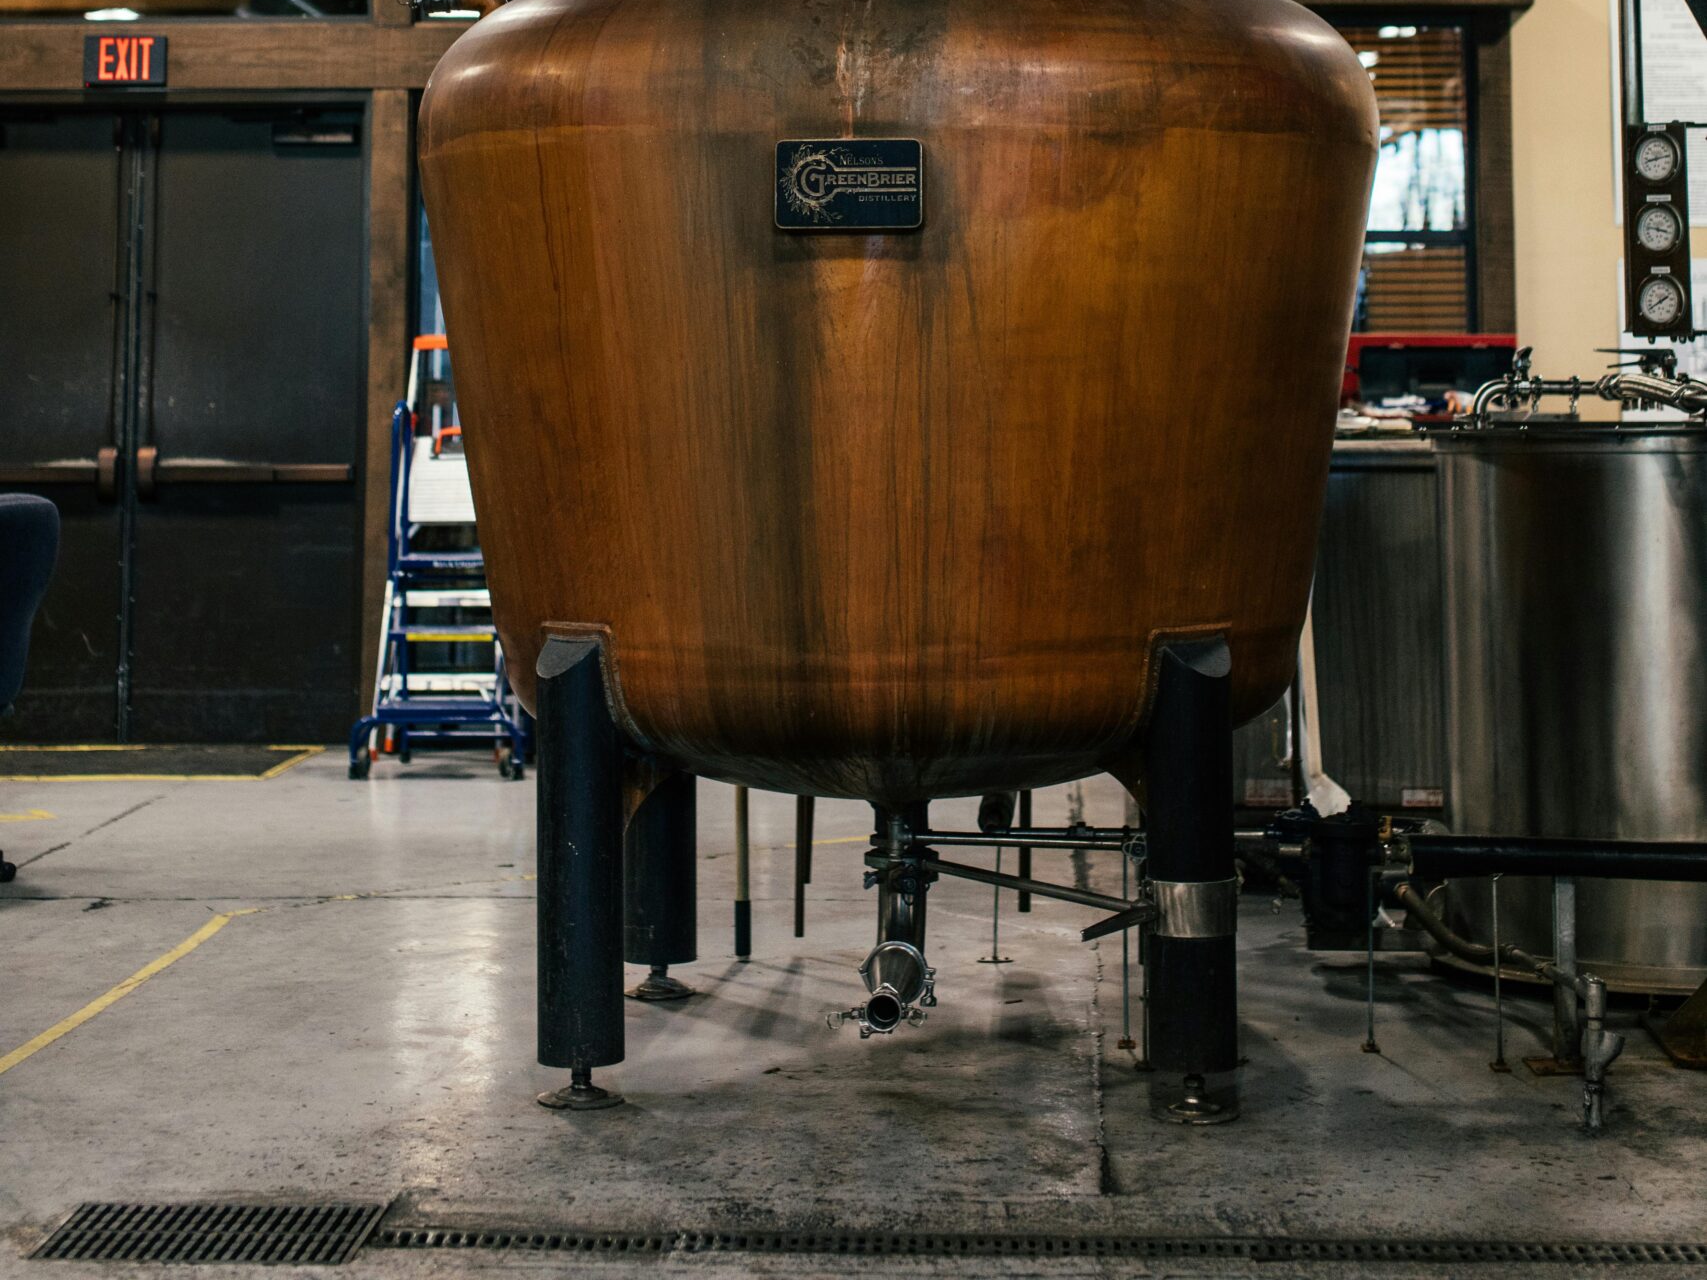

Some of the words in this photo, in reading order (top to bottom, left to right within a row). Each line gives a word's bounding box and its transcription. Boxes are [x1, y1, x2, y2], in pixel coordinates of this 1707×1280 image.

[98, 37, 154, 81] EXIT
[840, 154, 883, 166] NELSON'S
[800, 163, 917, 197] GREENBRIER
